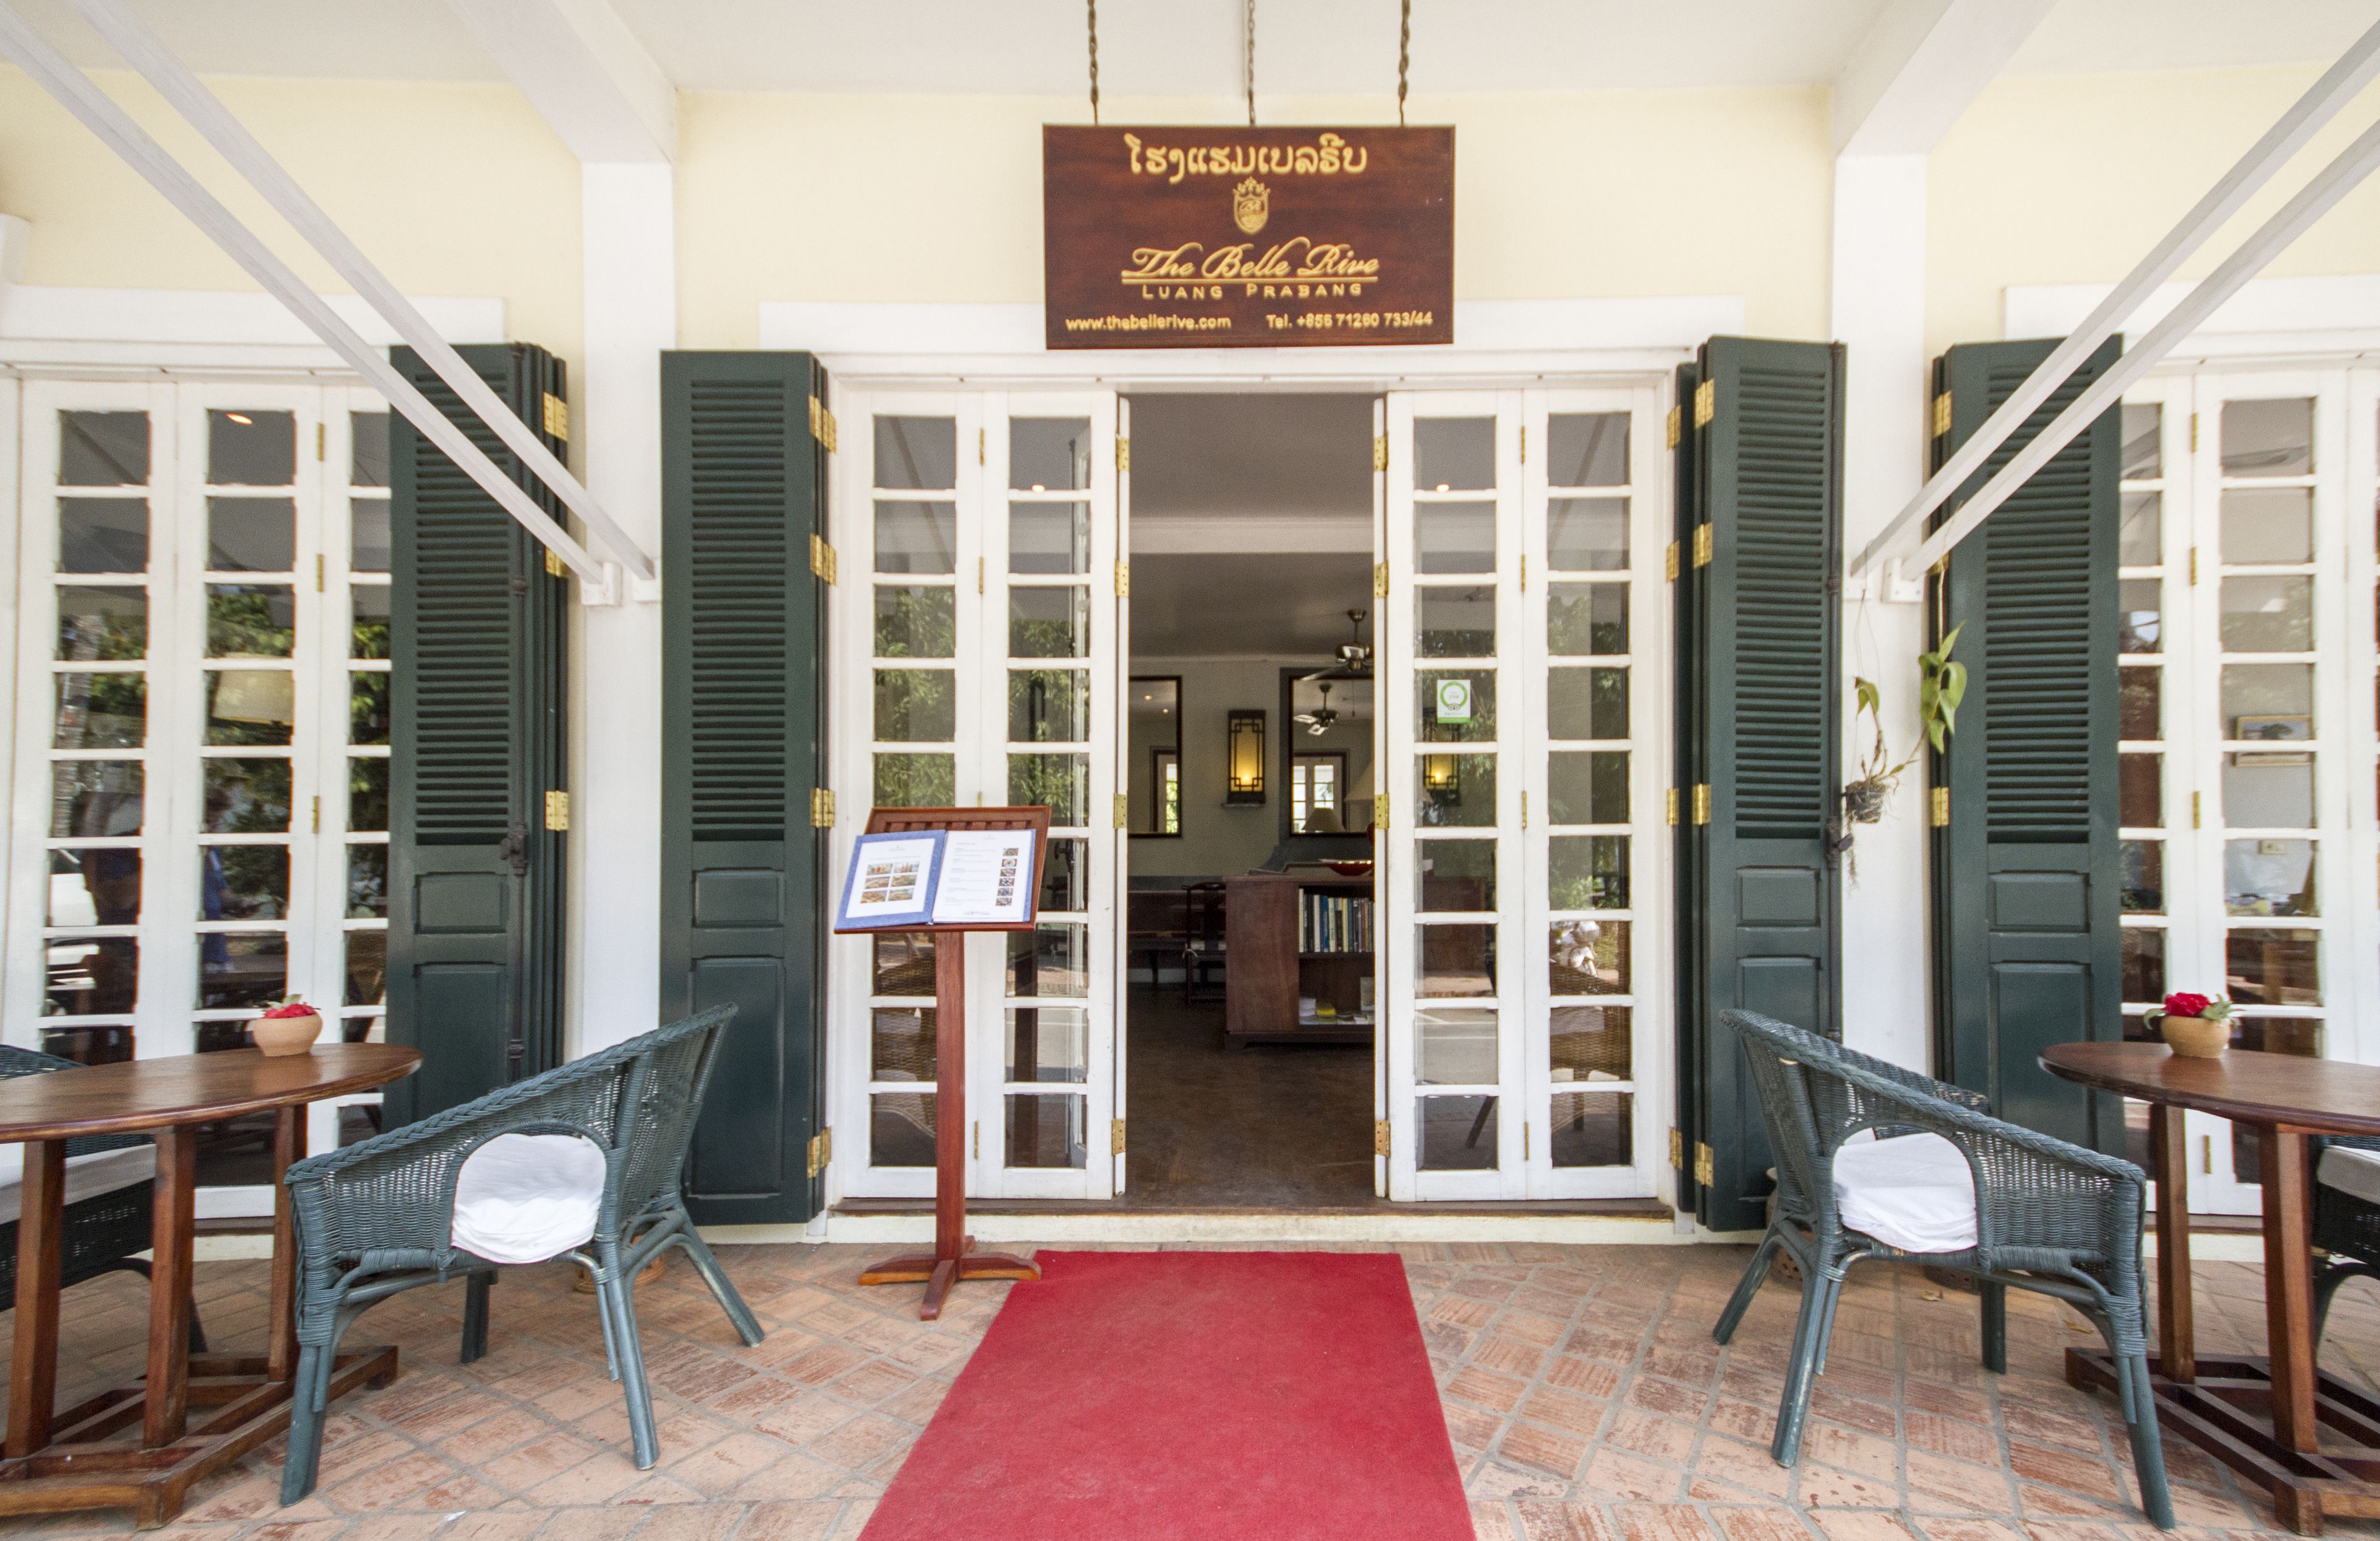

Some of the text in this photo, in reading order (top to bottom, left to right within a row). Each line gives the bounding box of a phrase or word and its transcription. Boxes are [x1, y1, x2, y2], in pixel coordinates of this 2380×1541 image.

[1121, 237, 1380, 278] The Belle Rive
[1142, 282, 1362, 299] LUANG PRABANG
[1065, 314, 1232, 331] www.thebellerive.com
[1266, 314, 1292, 330] Tel.
[1297, 313, 1333, 329] +856
